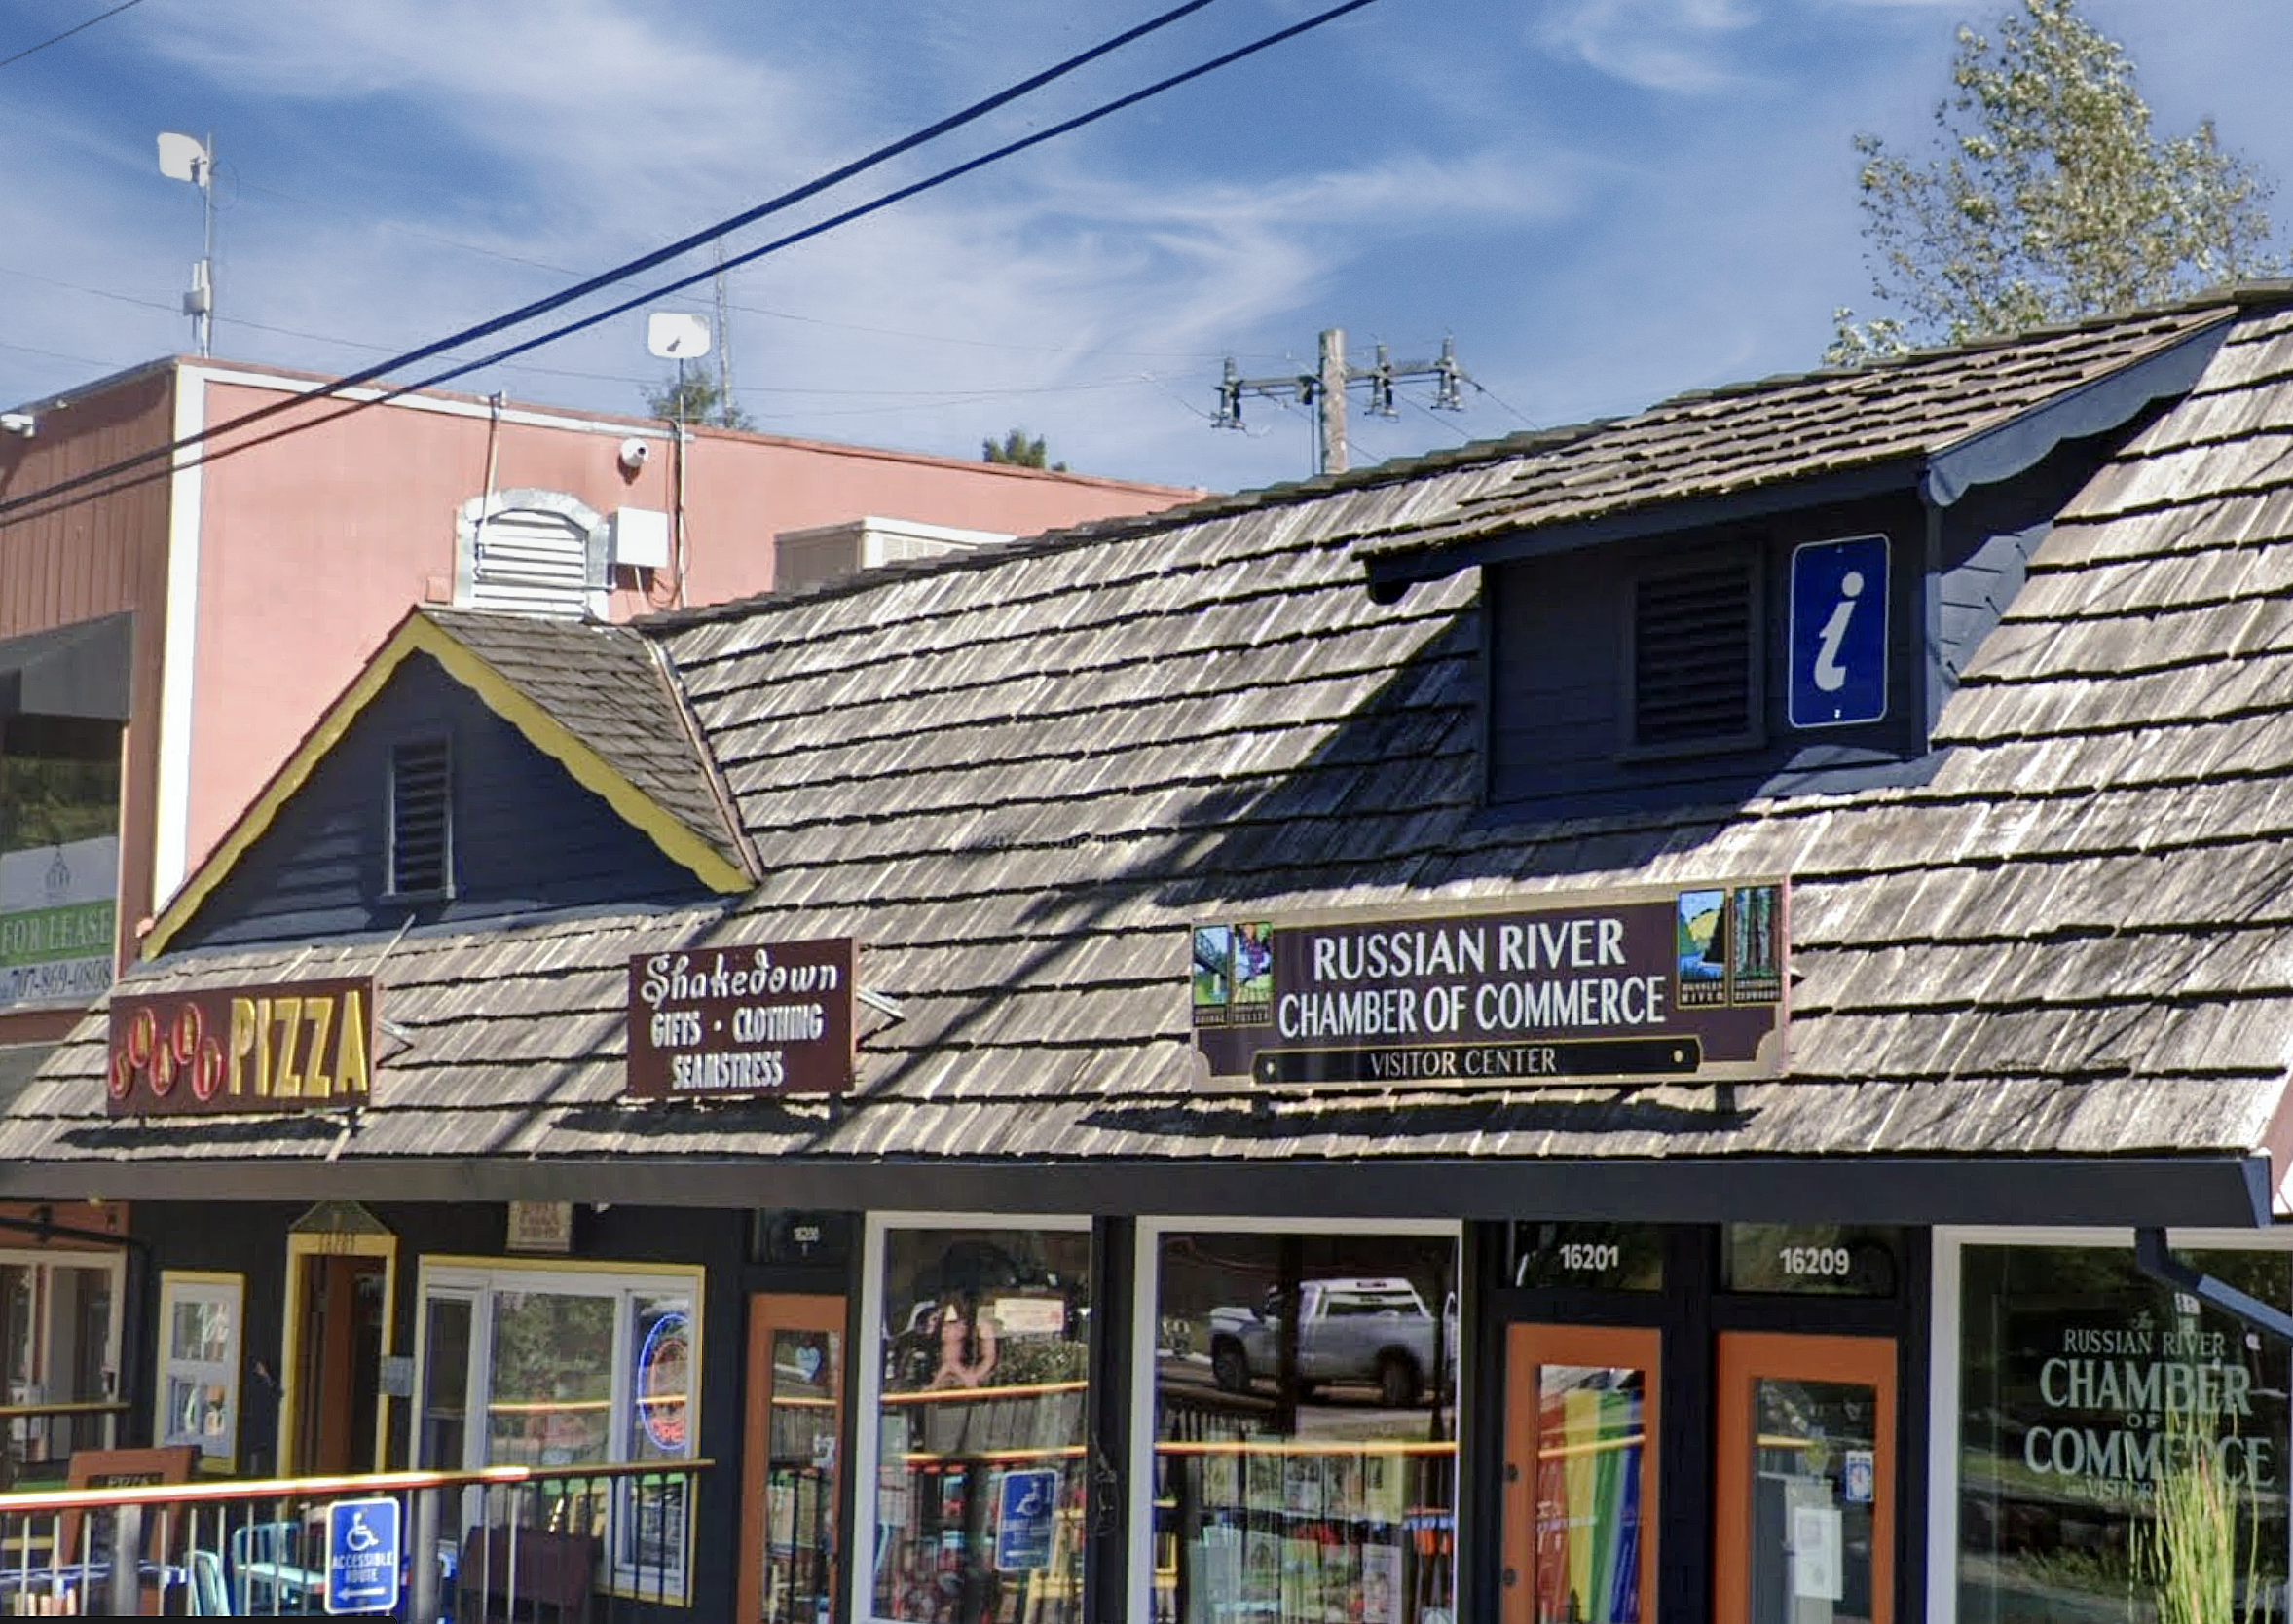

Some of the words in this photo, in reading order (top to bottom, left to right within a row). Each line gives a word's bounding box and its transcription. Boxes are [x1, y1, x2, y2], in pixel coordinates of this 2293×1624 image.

[3, 918, 42, 954] FOR
[49, 907, 112, 949] LEASE
[1314, 927, 1486, 982] RUSSIAN
[1498, 918, 1627, 972] RIVER
[640, 948, 838, 1011] Shakedown
[650, 1010, 703, 1047] GIFTS
[732, 1003, 824, 1043] CLOTHING
[1278, 987, 1418, 1038] CHAMBER
[1424, 985, 1468, 1033] OF
[1475, 975, 1668, 1031] COMMERCE
[228, 989, 368, 1098] PIZZA
[1370, 1050, 1458, 1078] VISITOR
[1464, 1047, 1558, 1074] CENTER
[672, 1050, 785, 1090] SEAMSTRESS
[1559, 1244, 1619, 1271] 16201
[1779, 1247, 1850, 1275] 16209
[2063, 1328, 2153, 1354] RUSSIAN
[2162, 1330, 2225, 1357] RIVER
[2039, 1357, 2253, 1416] CHAMBER
[2126, 1412, 2161, 1429] OF
